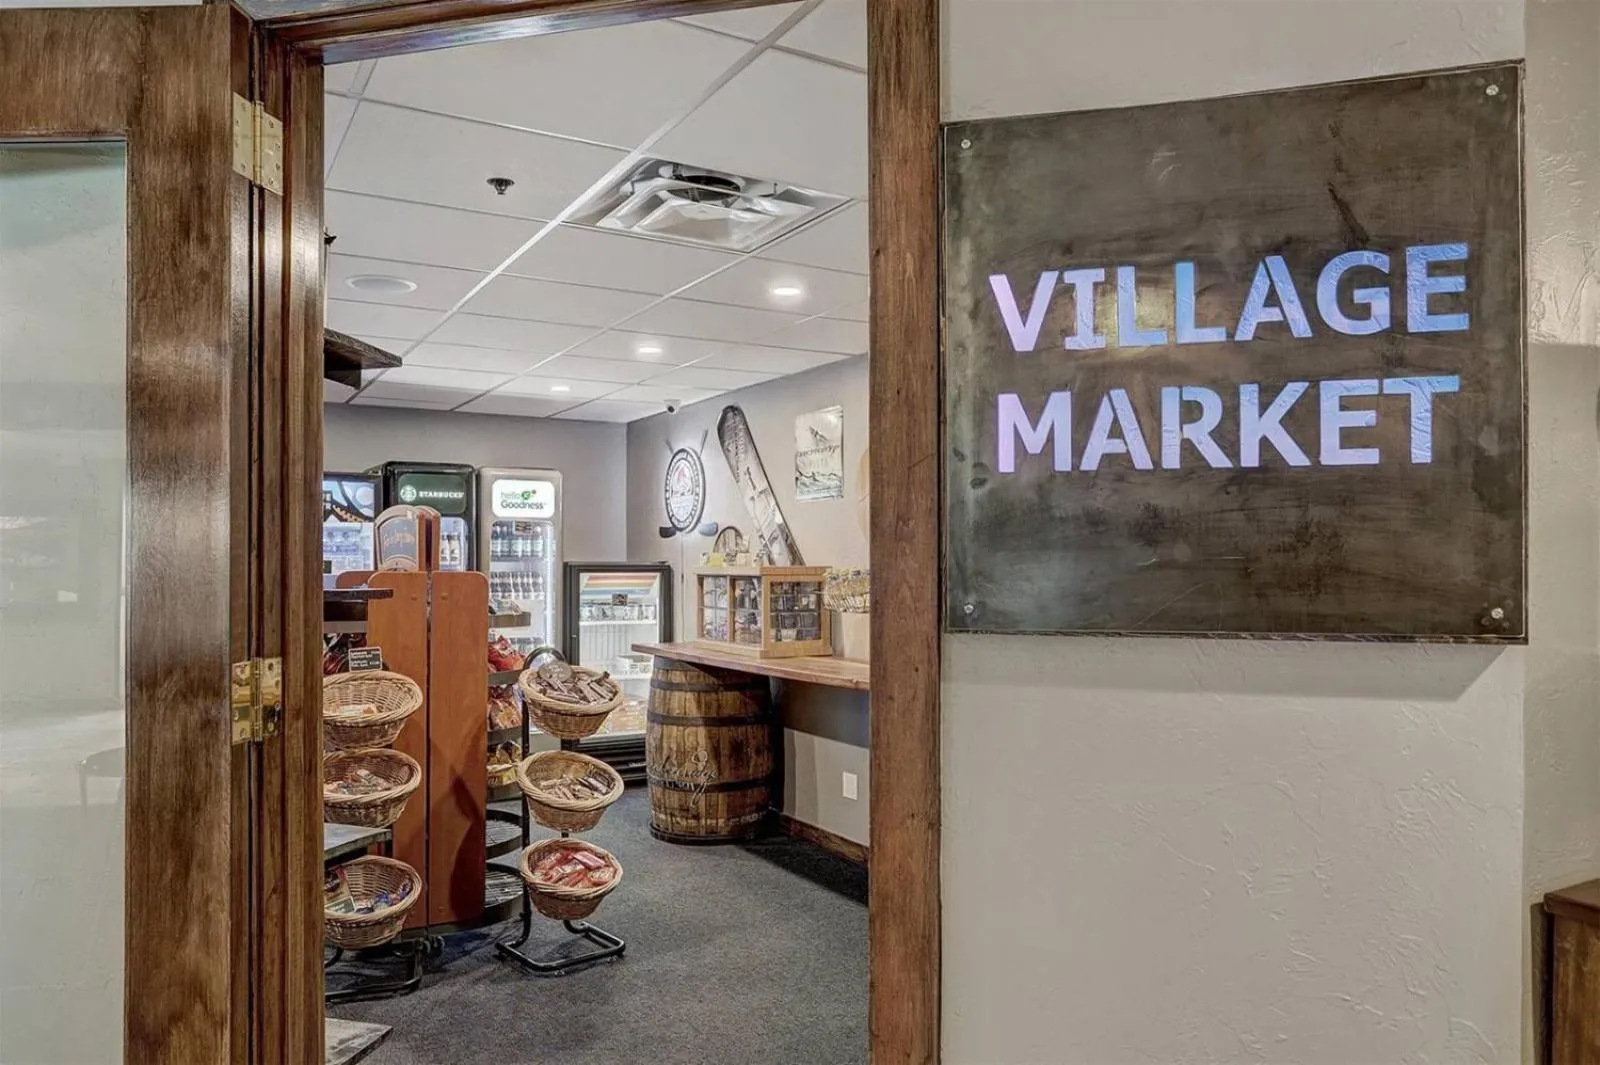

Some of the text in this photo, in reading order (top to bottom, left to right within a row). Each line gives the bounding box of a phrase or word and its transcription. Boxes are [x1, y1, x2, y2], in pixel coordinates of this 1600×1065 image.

[988, 242, 1470, 352] VILLAGE
[997, 375, 1461, 473] MARKET
[418, 490, 464, 498] STARBUCKS
[501, 491, 520, 500] hello
[501, 500, 544, 509] Goodness
